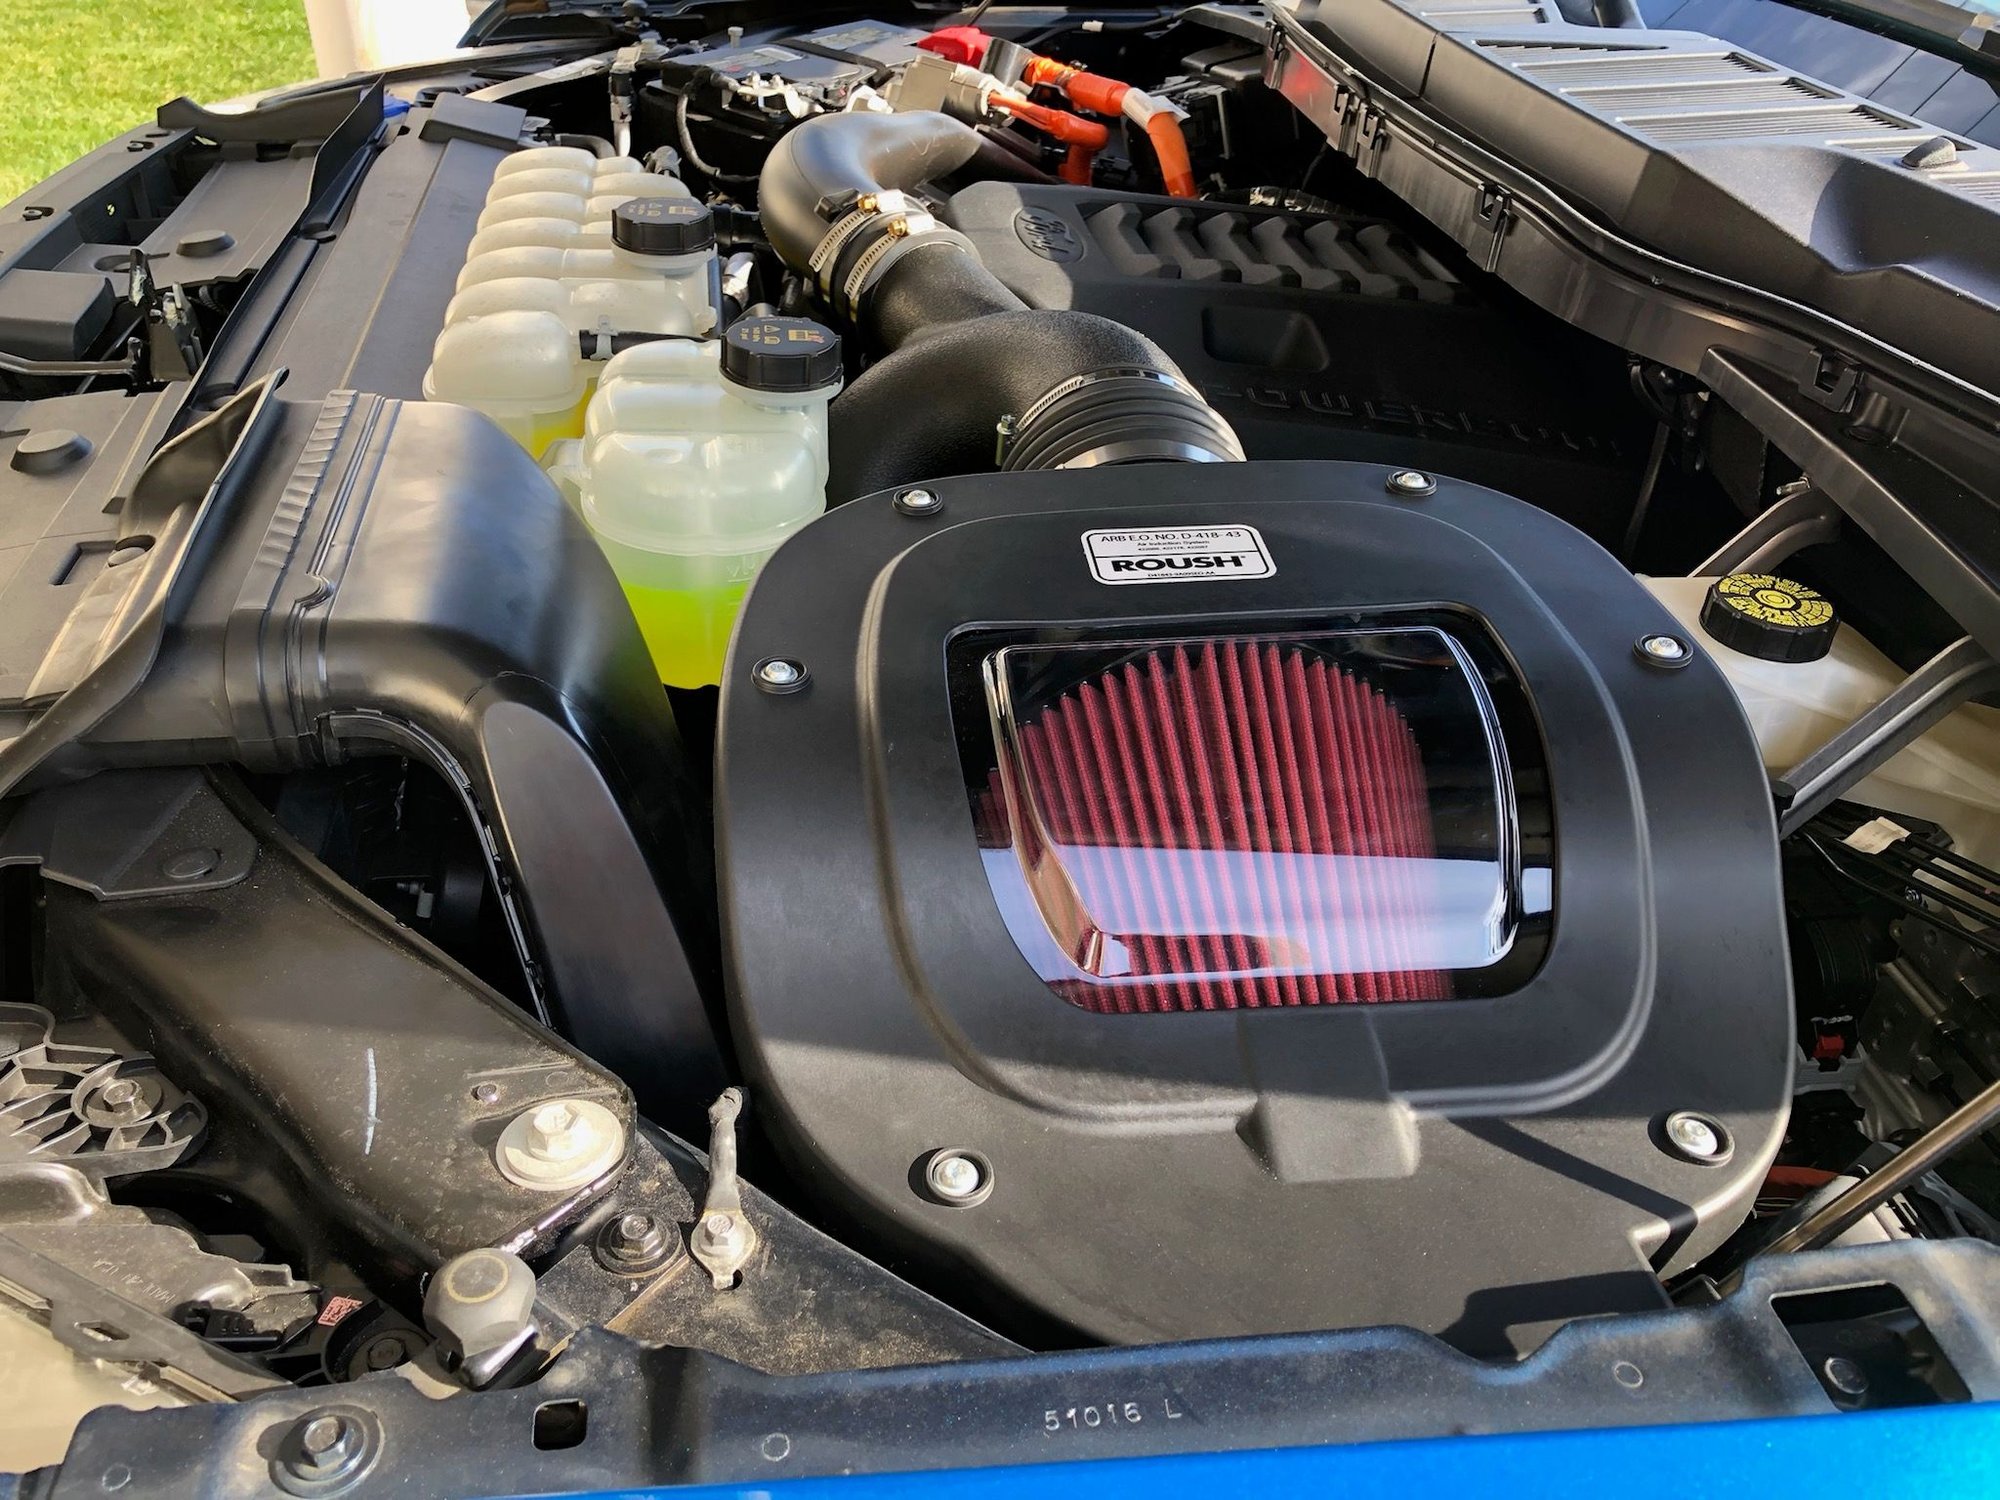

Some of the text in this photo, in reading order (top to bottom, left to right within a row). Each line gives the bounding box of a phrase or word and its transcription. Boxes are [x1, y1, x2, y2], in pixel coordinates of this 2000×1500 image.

[1111, 556, 1243, 572] ROUSH
[1044, 1399, 1182, 1431] 51016 L
